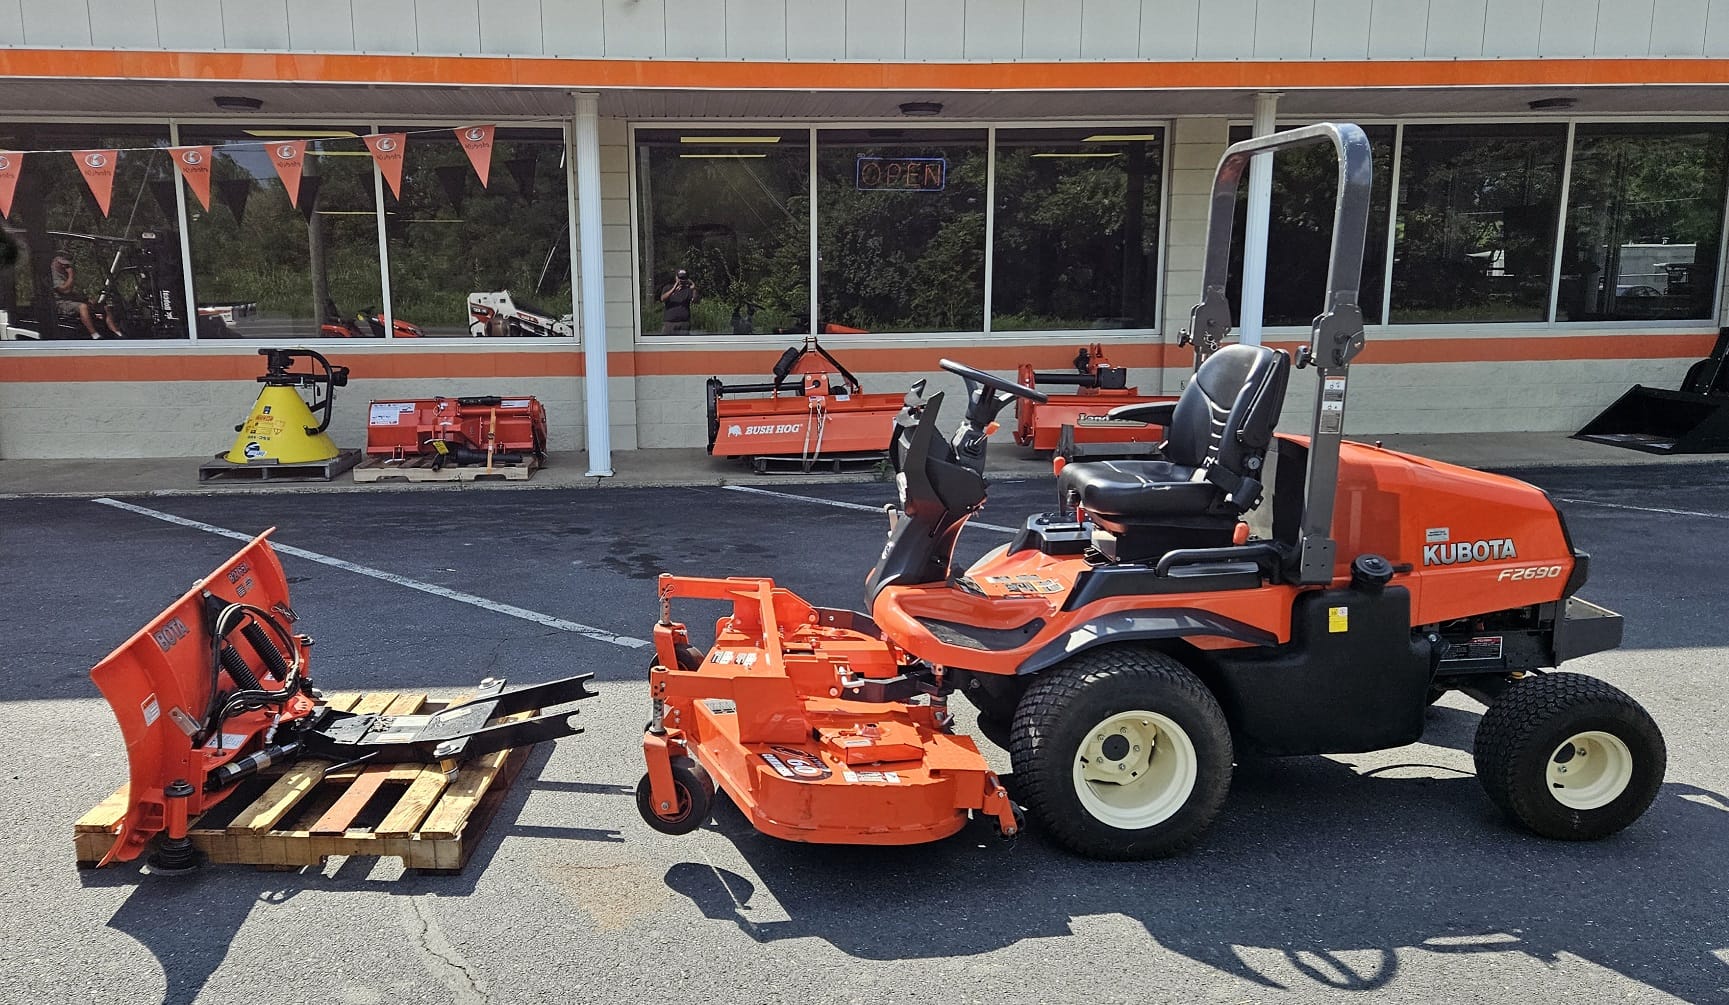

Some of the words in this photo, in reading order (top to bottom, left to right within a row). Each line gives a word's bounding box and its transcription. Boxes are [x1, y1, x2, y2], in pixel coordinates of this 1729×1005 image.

[862, 162, 941, 187] OPEN
[745, 425, 774, 435] BUSH
[775, 423, 800, 433] HOG
[1423, 538, 1517, 566] KUBOTA
[1497, 566, 1562, 582] F2690
